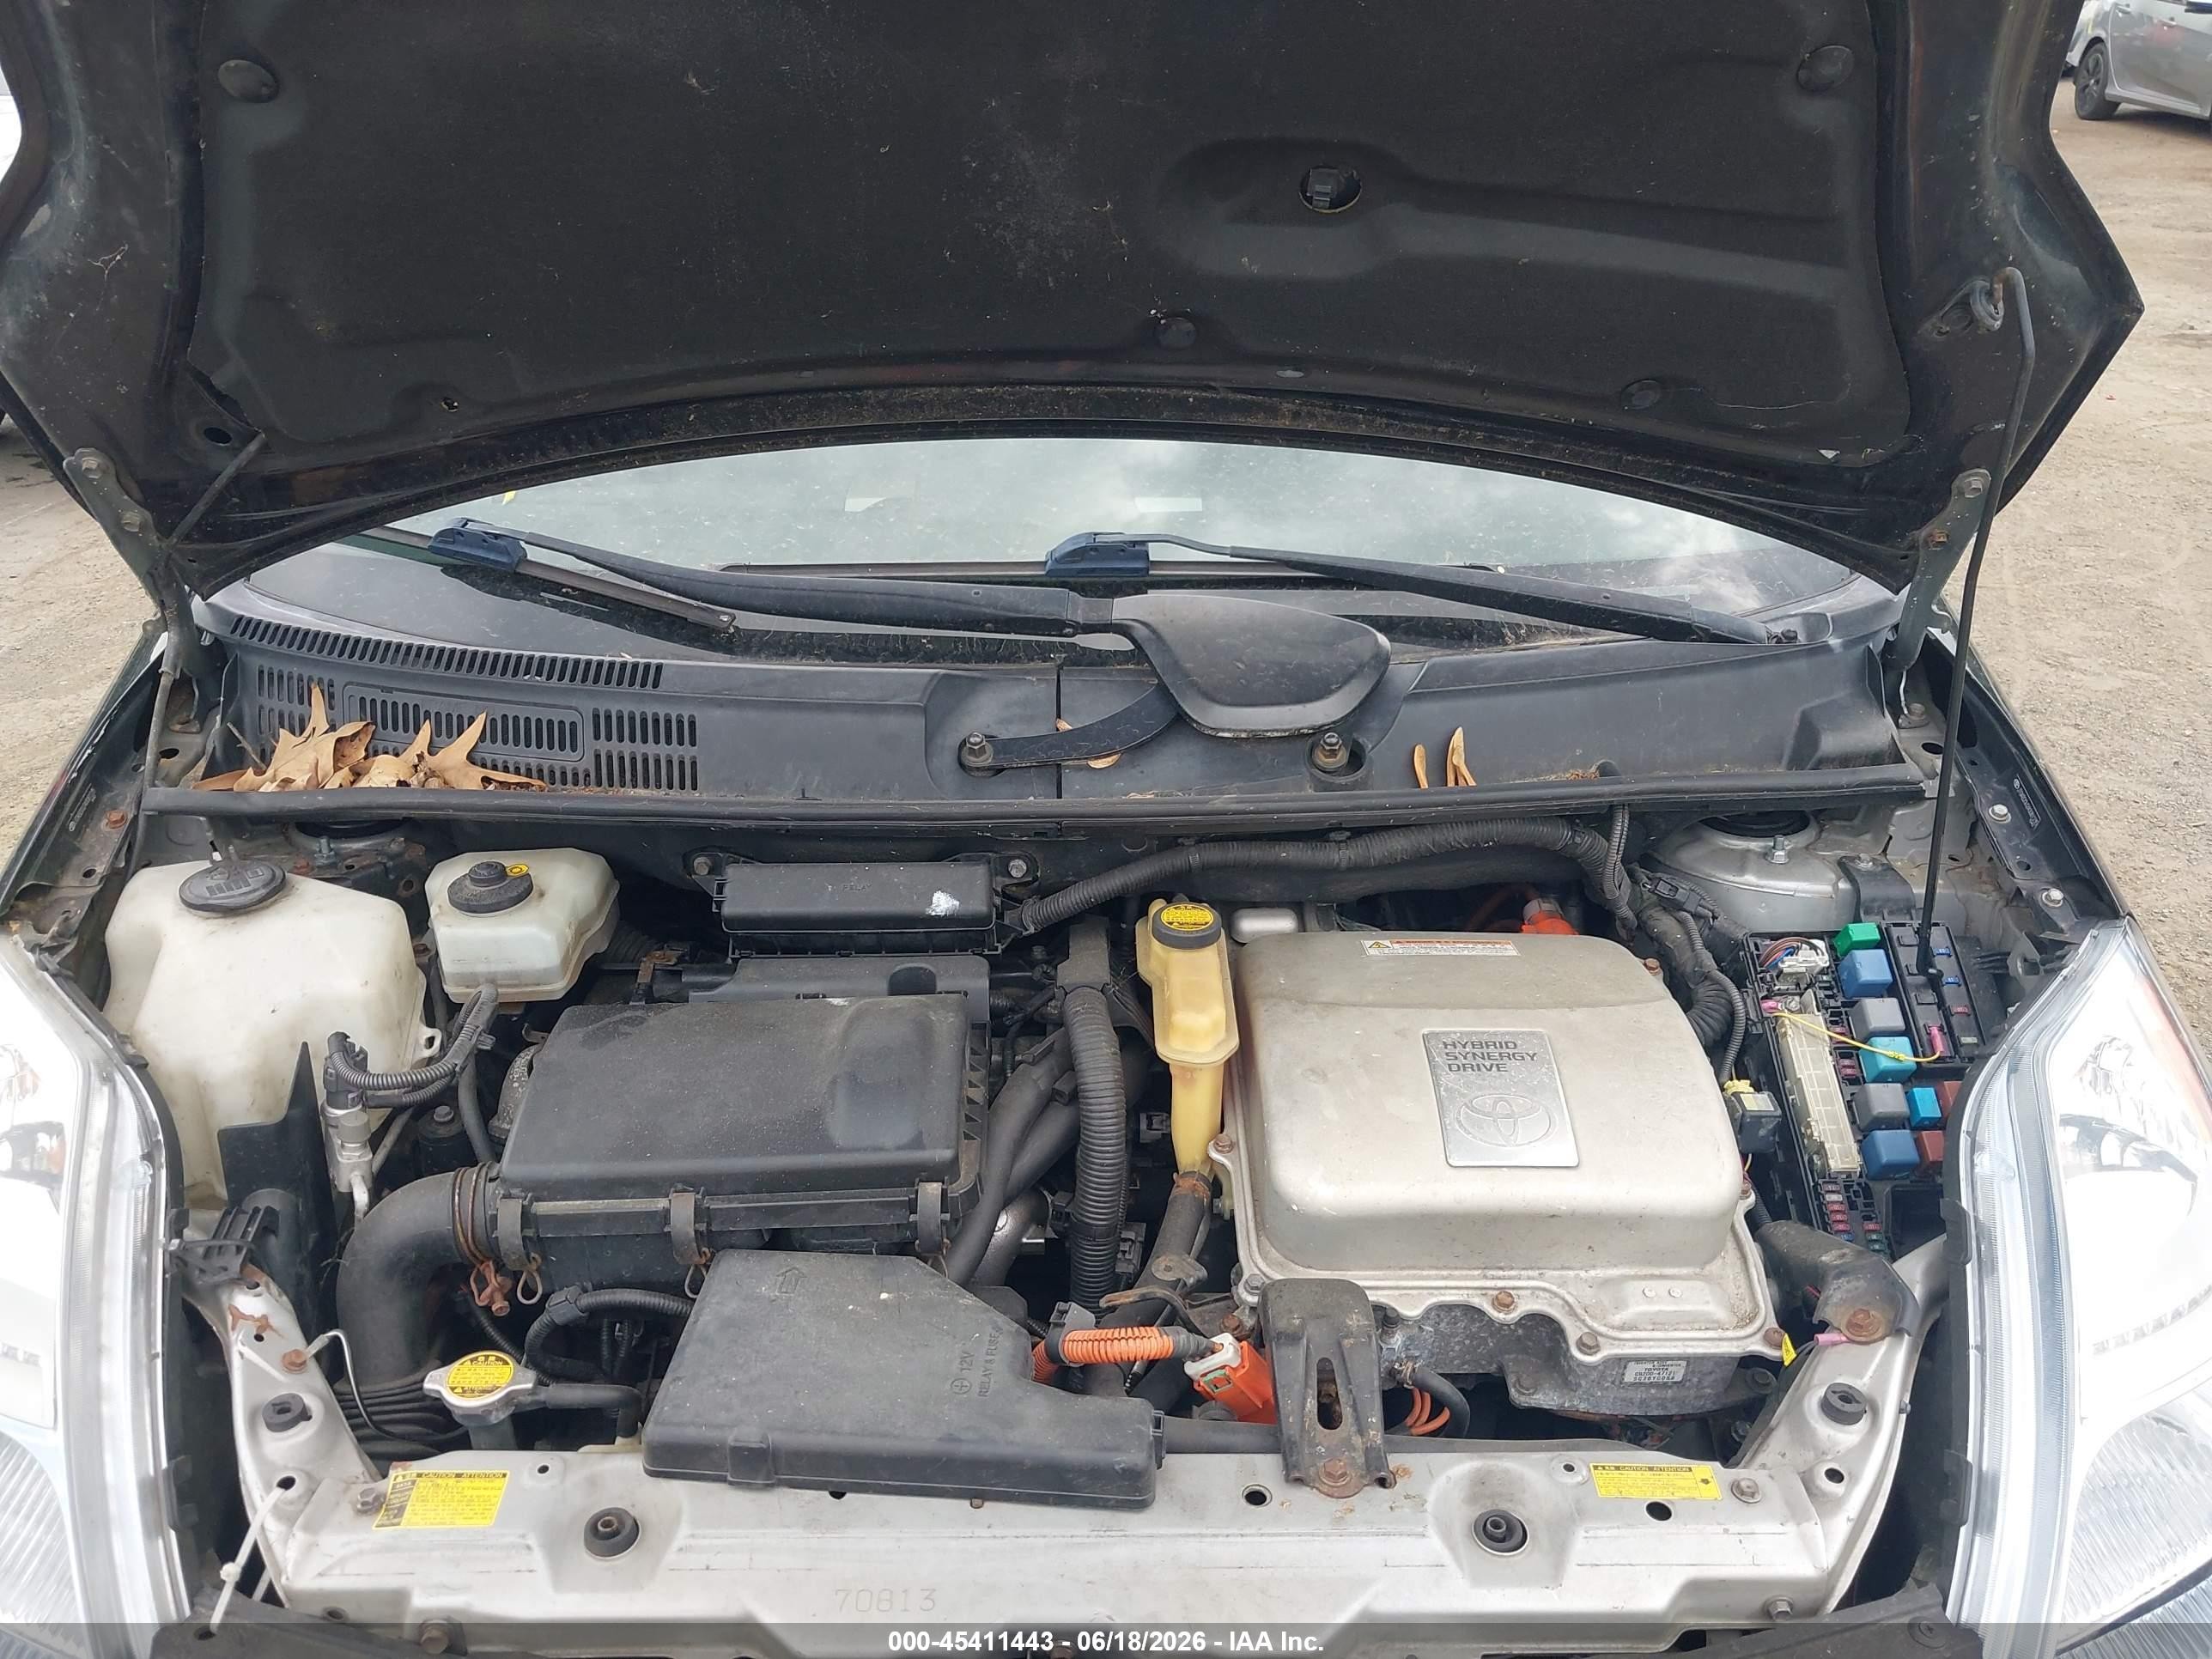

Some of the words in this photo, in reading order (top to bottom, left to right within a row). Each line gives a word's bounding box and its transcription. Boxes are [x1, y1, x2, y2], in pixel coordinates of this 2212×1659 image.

[1442, 1040, 1518, 1050] HYBRID
[1444, 1051, 1538, 1061] SYNERGY
[1448, 1062, 1510, 1073] DRIVE
[958, 1351, 975, 1372] 12V
[978, 1366, 993, 1398] RELAY
[986, 1332, 998, 1357] FUSE
[835, 1587, 938, 1613] 70813
